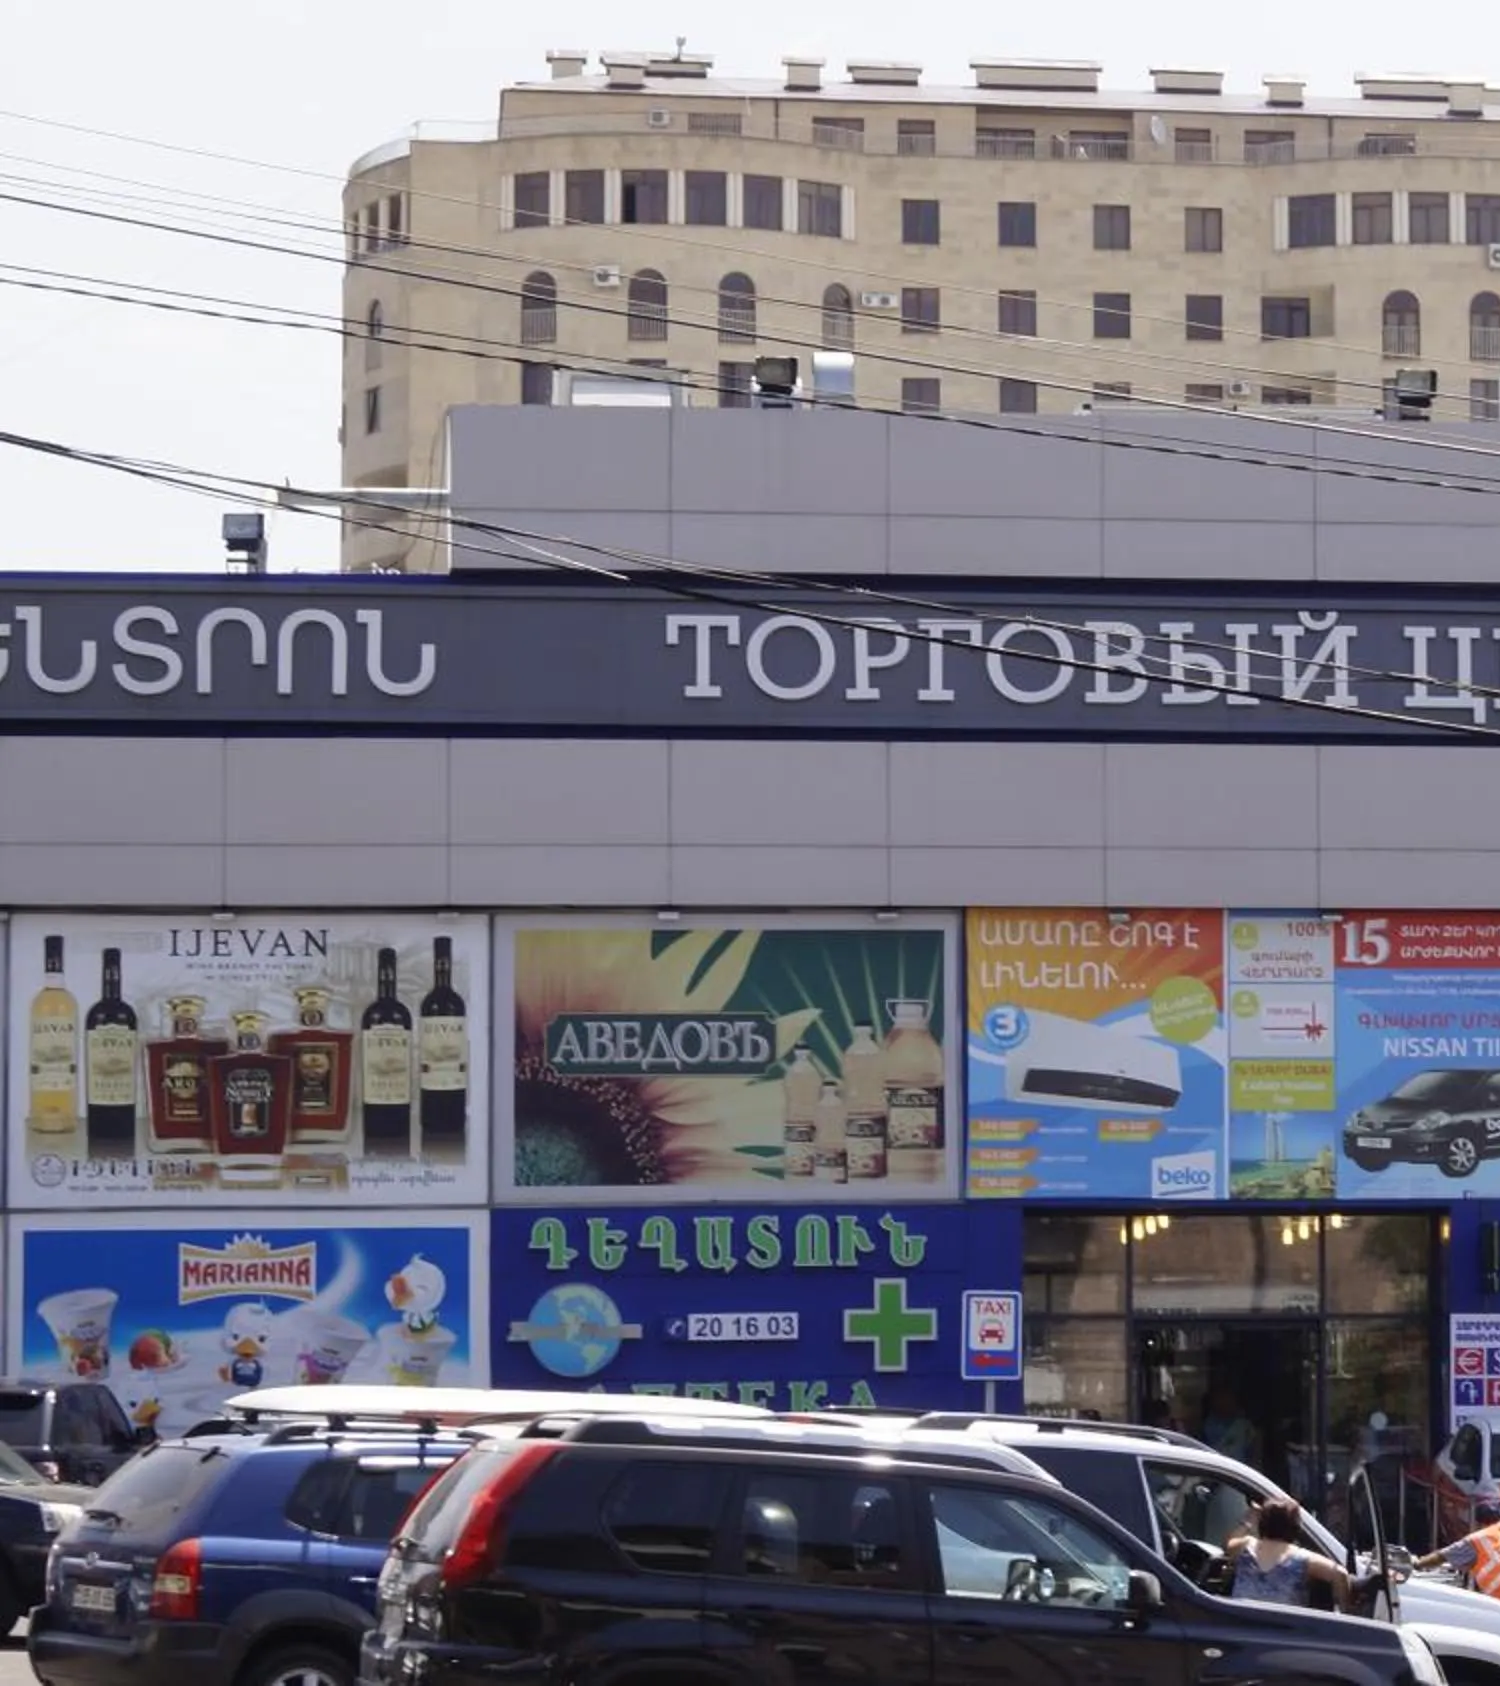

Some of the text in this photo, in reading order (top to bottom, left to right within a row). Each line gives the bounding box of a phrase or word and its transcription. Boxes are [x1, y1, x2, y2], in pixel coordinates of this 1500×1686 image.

[0, 605, 437, 696] ՆՏՐՈՆ
[665, 610, 1358, 706] ТОРГОВЫЙ
[168, 928, 331, 958] IJEVAN
[980, 919, 1101, 947] ԱՄԱՌԸ
[1342, 919, 1391, 965] 15
[552, 1019, 771, 1071] АВЕДОВЪ
[1383, 1038, 1467, 1057] NISSAN
[1157, 1167, 1212, 1186] beko
[528, 1211, 928, 1273] ԴԵՂԱՏՈՒՆ
[182, 1256, 312, 1287] MARIANNA
[974, 1300, 1011, 1314] TAXI
[695, 1315, 795, 1337] 20 16 03
